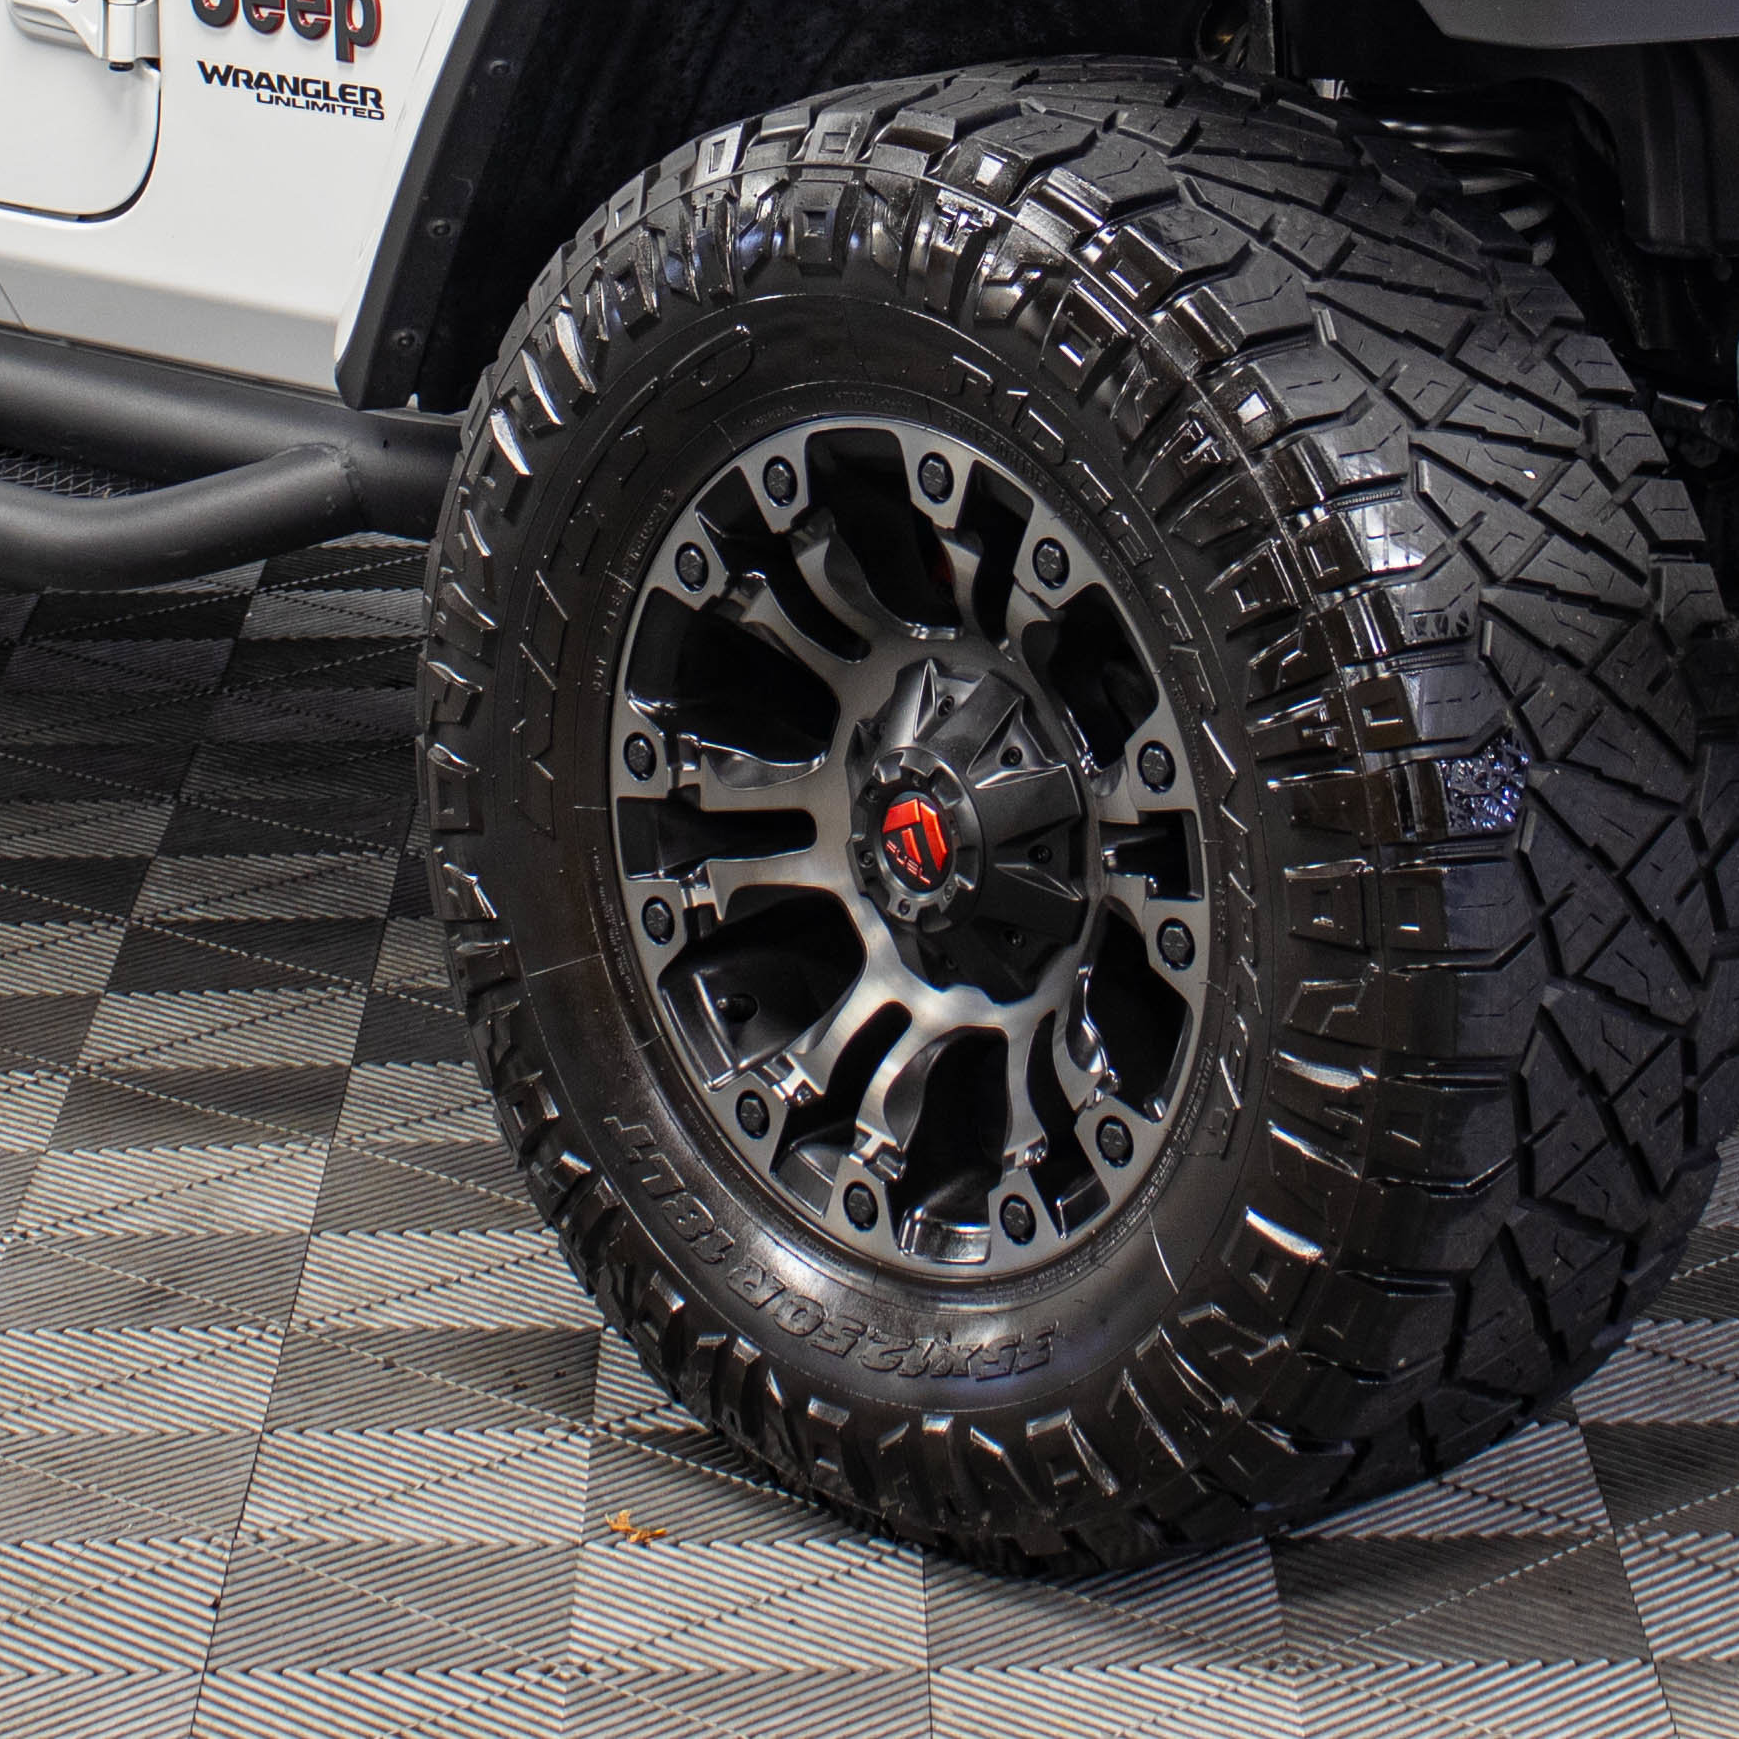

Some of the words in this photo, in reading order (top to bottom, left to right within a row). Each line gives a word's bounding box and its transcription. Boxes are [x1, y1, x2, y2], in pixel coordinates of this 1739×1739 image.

[196, 59, 384, 110] WRANGLER
[255, 92, 385, 121] UNLIMITED
[885, 839, 931, 885] FUEL
